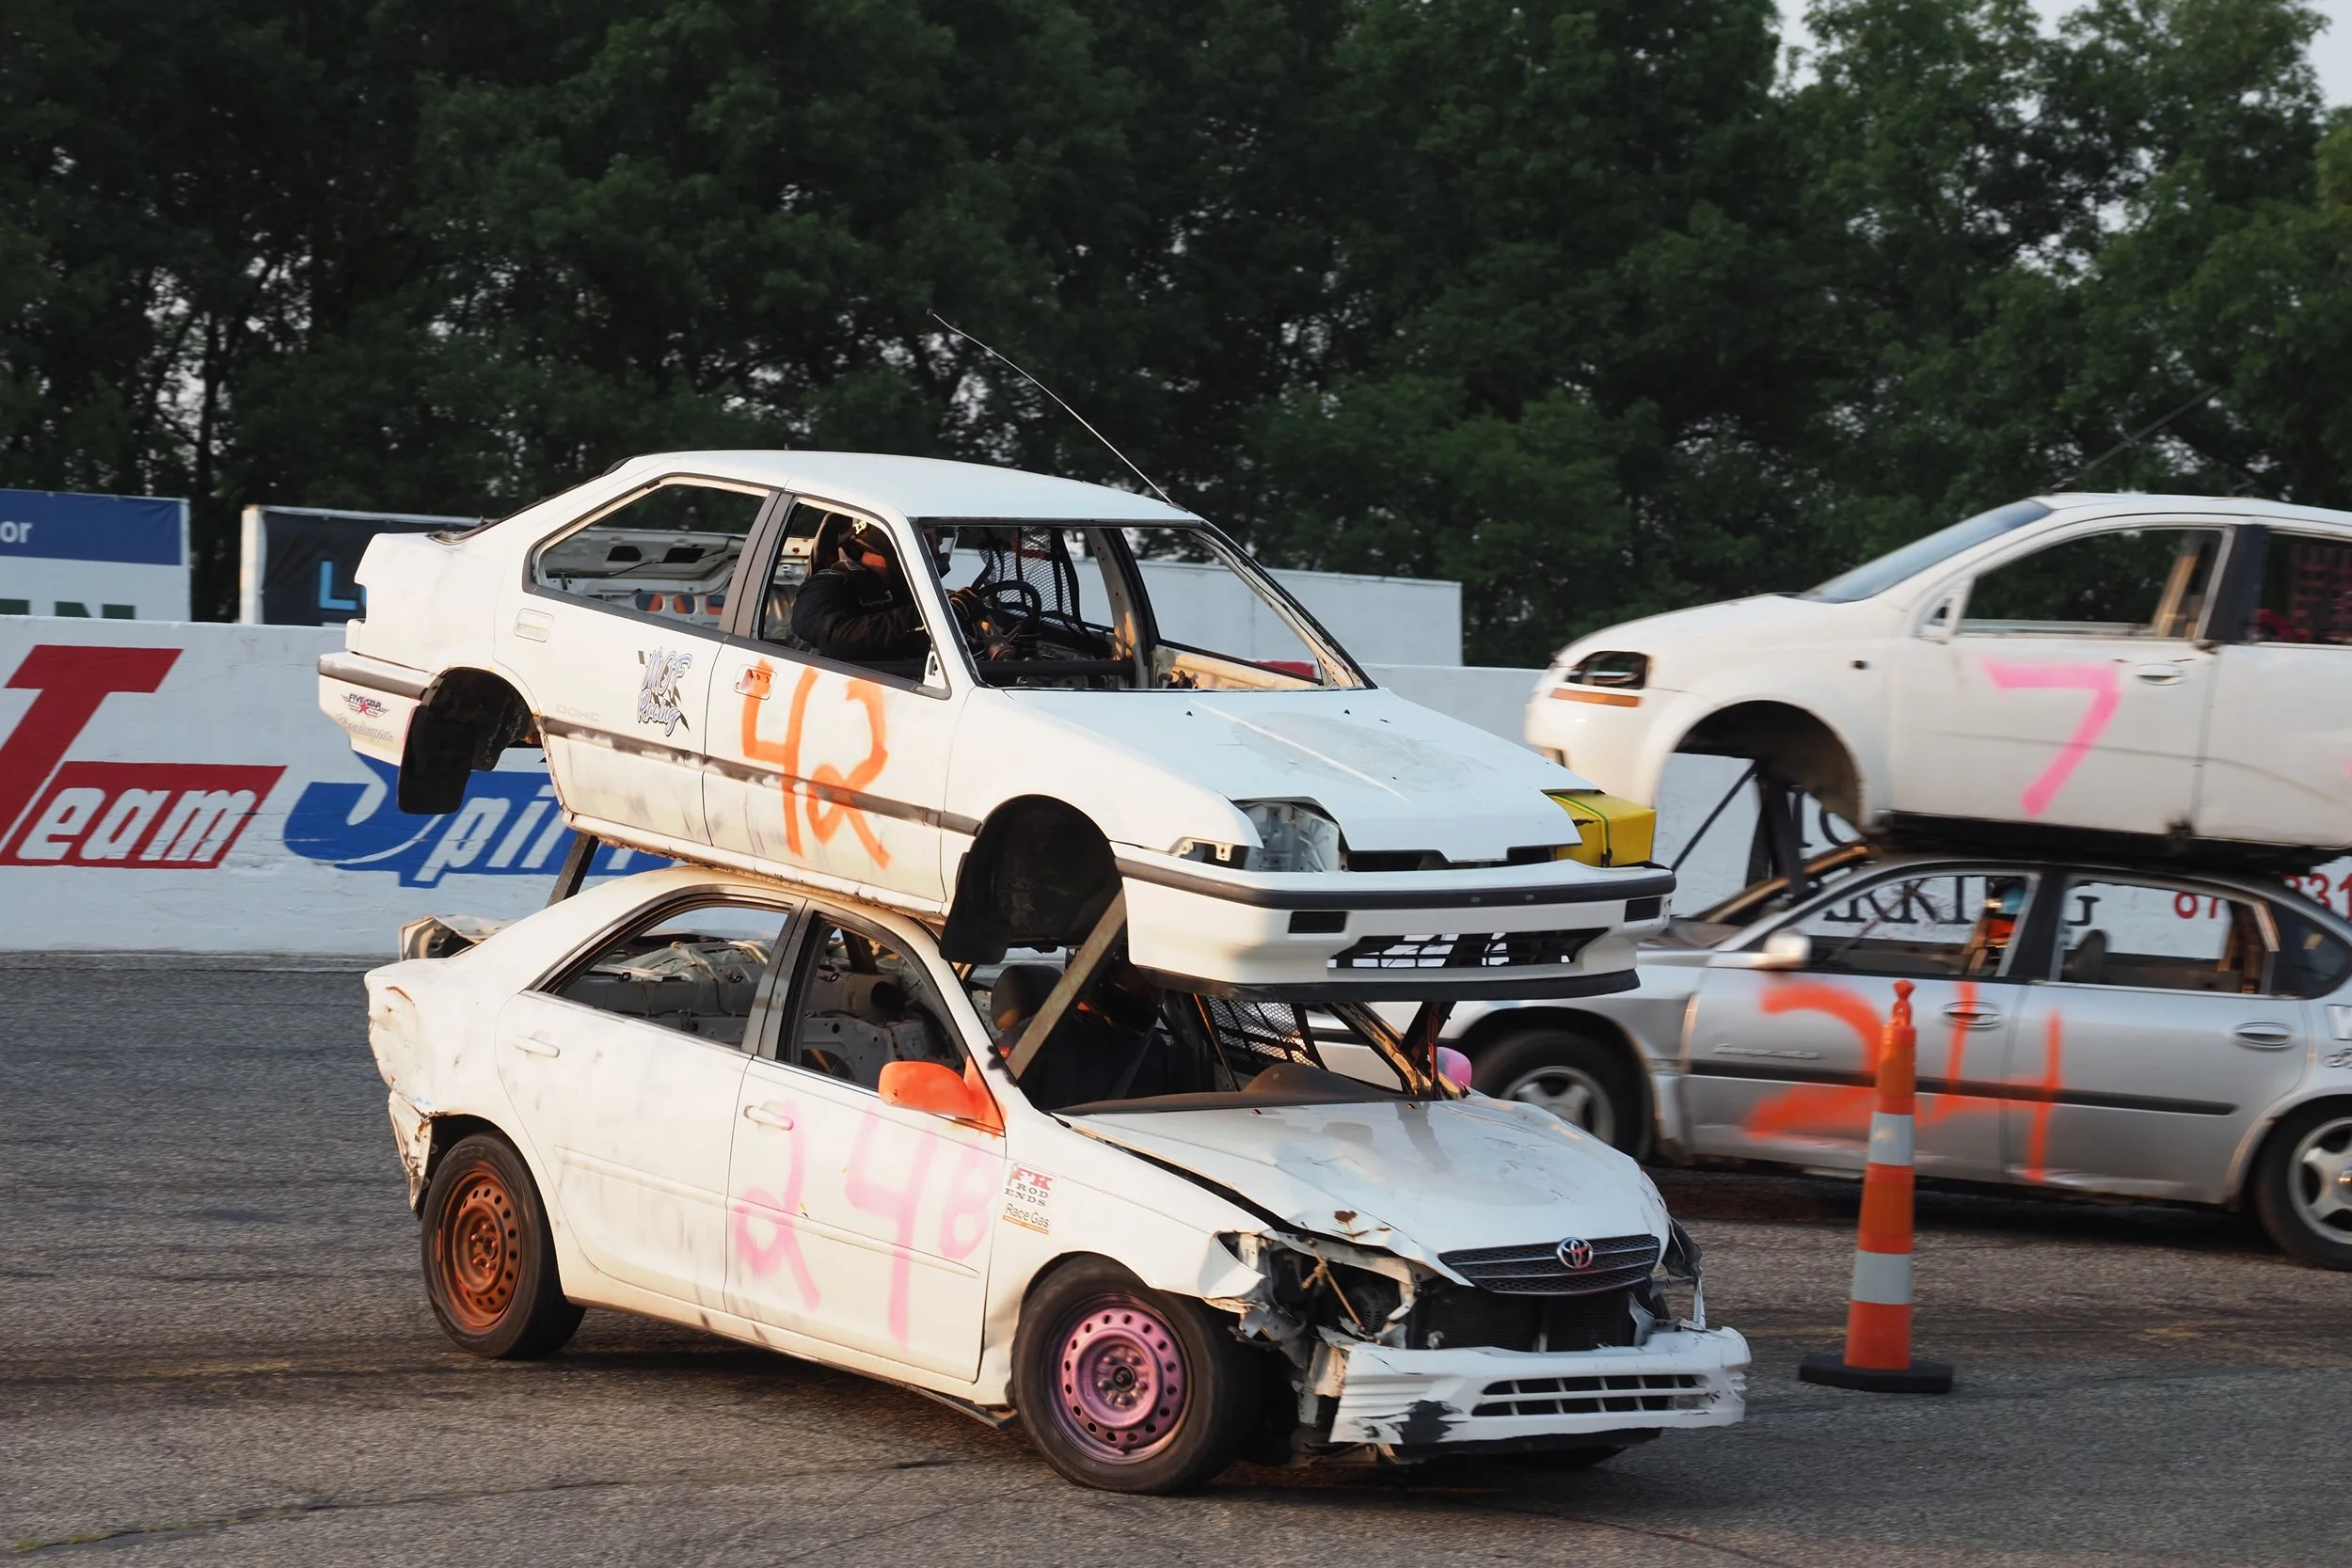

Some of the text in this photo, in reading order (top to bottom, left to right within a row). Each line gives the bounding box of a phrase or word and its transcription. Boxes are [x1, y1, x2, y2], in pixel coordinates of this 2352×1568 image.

[638, 689, 681, 737] Racing
[1983, 657, 2122, 816] 7
[0, 645, 287, 869] Team
[741, 657, 892, 870] 42
[1004, 1187, 1046, 1207] ENDS
[1011, 1166, 1053, 1191] FK
[1016, 1182, 1049, 1198] ROD
[1005, 1202, 1050, 1228] Race Gas
